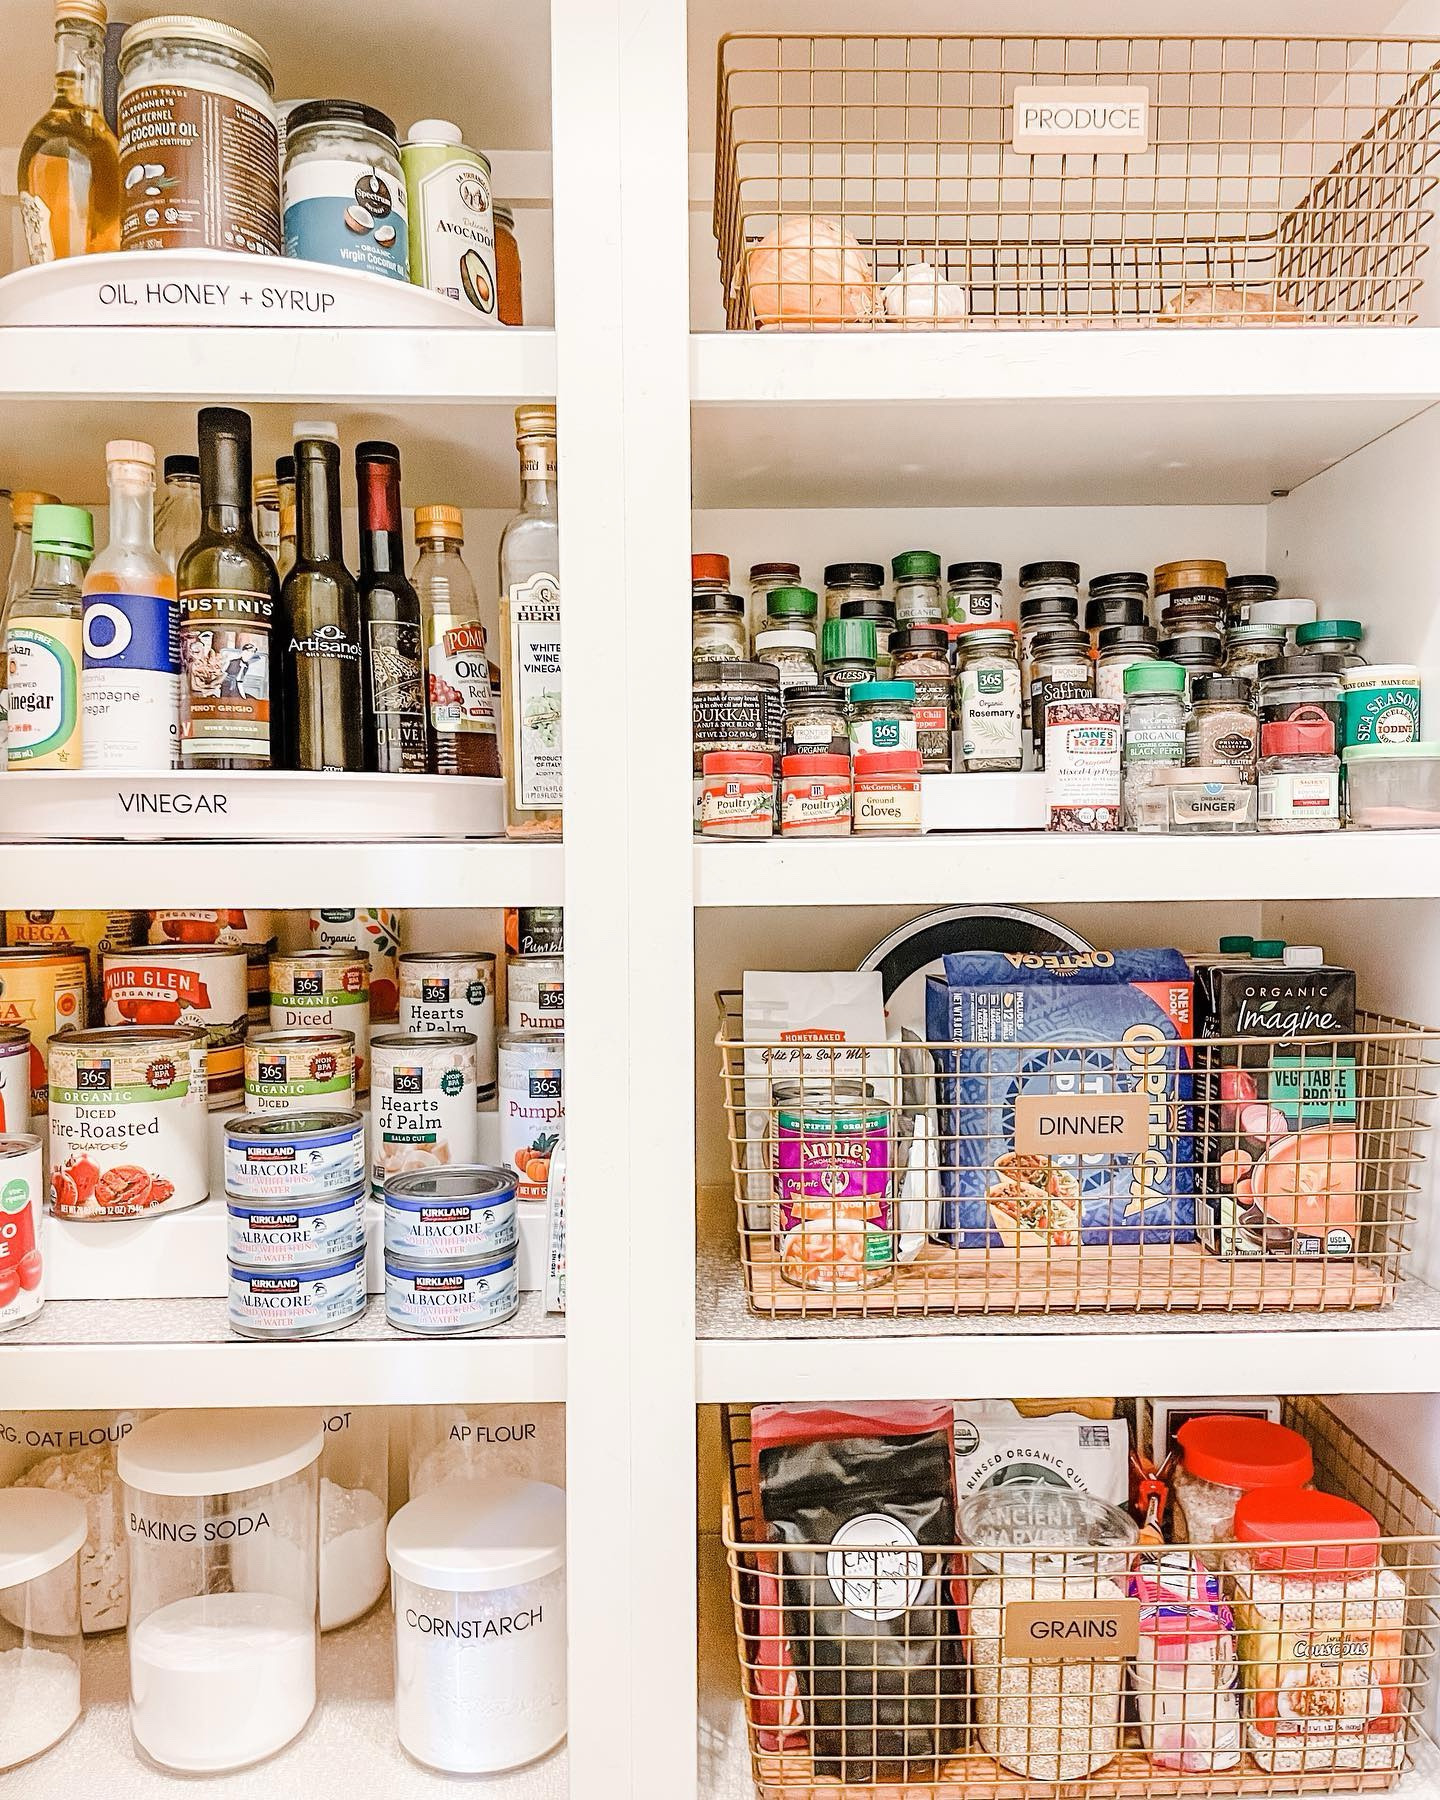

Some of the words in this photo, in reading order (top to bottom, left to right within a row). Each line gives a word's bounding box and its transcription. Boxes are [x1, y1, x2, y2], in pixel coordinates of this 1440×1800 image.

[142, 109, 173, 123] KERNEL
[1025, 108, 1140, 129] PRODUCE
[131, 122, 178, 143] COCONUT
[180, 122, 200, 138] OIL
[355, 188, 391, 207] Spectrum
[437, 219, 491, 248] AVOCADO
[361, 244, 391, 258] ORGANIC
[340, 248, 366, 263] Virgin
[368, 252, 396, 270] Coconut
[99, 284, 137, 306] OIL,
[146, 283, 230, 305] HONEY
[240, 291, 253, 305] +
[261, 287, 335, 313] SYRUP
[180, 598, 273, 616] FUSTINI'S
[972, 598, 992, 608] 365
[900, 608, 938, 618] ORGANIC
[82, 602, 133, 660] O
[288, 637, 362, 657] Artisano's
[529, 643, 561, 653] WHITE
[533, 654, 560, 663] WINE
[523, 664, 562, 673] VINEGA
[836, 671, 866, 681] ALESSI
[979, 674, 1002, 687] 365
[1044, 682, 1093, 701] Saffron
[1357, 681, 1376, 689] COAST
[469, 686, 488, 700] Red
[190, 704, 215, 714] PINOT
[218, 703, 253, 714] GRIGIO
[979, 700, 1004, 709] Organic
[693, 708, 761, 722] DUKKAH
[923, 711, 942, 719] Chili
[969, 709, 1015, 720] Rosemary
[204, 725, 224, 733] WINE
[874, 725, 898, 739] 365
[1357, 715, 1375, 742] SEA
[1378, 725, 1412, 734] IODINE
[377, 728, 419, 745] OLIVE
[1134, 732, 1180, 741] ORGANIC
[1219, 739, 1248, 747] PRIVATE
[797, 746, 829, 755] ORGANIC
[1130, 747, 1158, 756] BLACK
[1075, 756, 1112, 768] Original
[118, 792, 229, 814] VINEGAR
[717, 798, 753, 810] Poultry
[801, 800, 838, 811] Poultry
[866, 796, 895, 804] Ground
[1191, 802, 1236, 812] GINGER
[861, 804, 902, 818] Cloves
[159, 911, 211, 919] ORGANIC
[16, 925, 71, 941] REGA
[320, 931, 357, 946] Organic
[1003, 950, 1115, 971] ORTEGA
[107, 970, 136, 990] MUIR
[143, 971, 191, 991] GLEN
[297, 979, 319, 992] 365
[114, 990, 171, 999] ORGANIC
[425, 987, 446, 1000] 365
[953, 992, 962, 1005] NET
[1245, 986, 1329, 997] ORGANIC
[282, 996, 339, 1006] ORGANIC
[543, 993, 564, 1006] 365
[1168, 988, 1177, 1016] LOOK
[1177, 988, 1188, 1024] NEW
[286, 1010, 333, 1026] Diced
[410, 1005, 465, 1020] Hearts
[953, 1006, 962, 1016] WT
[1004, 1008, 1013, 1020] 12
[1016, 991, 1024, 1031] INCLUDES:
[408, 1020, 422, 1032] of
[425, 1020, 467, 1033] Palm
[1236, 1000, 1337, 1047] Imagine
[785, 1033, 841, 1042] HONEYBAKED
[953, 1029, 962, 1037] OZ
[261, 1066, 282, 1080] 365
[317, 1063, 331, 1071] BPA
[81, 1071, 106, 1089] 365
[154, 1071, 169, 1080] BPA
[249, 1084, 305, 1095] ORGANIC
[397, 1076, 419, 1091] 365
[533, 1078, 559, 1094] 365
[64, 1092, 133, 1103] ORGANIC
[258, 1097, 290, 1109] DICED
[381, 1096, 439, 1112] Hearts
[75, 1106, 116, 1119] DICED
[379, 1113, 393, 1129] of
[397, 1113, 442, 1130] Palm
[1039, 1115, 1124, 1136] DINNER
[1121, 1024, 1168, 1217] ORTEGA
[52, 1117, 160, 1139] Fire-Roasted
[67, 1141, 129, 1151] TOMATOES
[247, 1146, 296, 1157] KIRKLAND
[238, 1162, 308, 1177] ALBACORE
[422, 1207, 470, 1218] KIRKLAND
[250, 1215, 298, 1225] KIRKLAND
[410, 1222, 482, 1237] ALBACORE
[240, 1230, 311, 1244] ALBACORE
[251, 1278, 298, 1289] KIRKLAND
[416, 1276, 463, 1287] KIRKLAND
[241, 1295, 311, 1309] ALBACORE
[404, 1291, 476, 1306] ALBACORE
[26, 1430, 64, 1447] OAT
[449, 1424, 472, 1441] AP
[476, 1423, 537, 1443] FLOUR
[966, 1454, 1002, 1491] RINSED
[1007, 1448, 1064, 1468] ORGANIC
[130, 1513, 197, 1542] BAKING
[204, 1512, 271, 1541] SODA
[405, 1605, 543, 1639] CORNSTARCH
[1030, 1620, 1118, 1639] GRAINS
